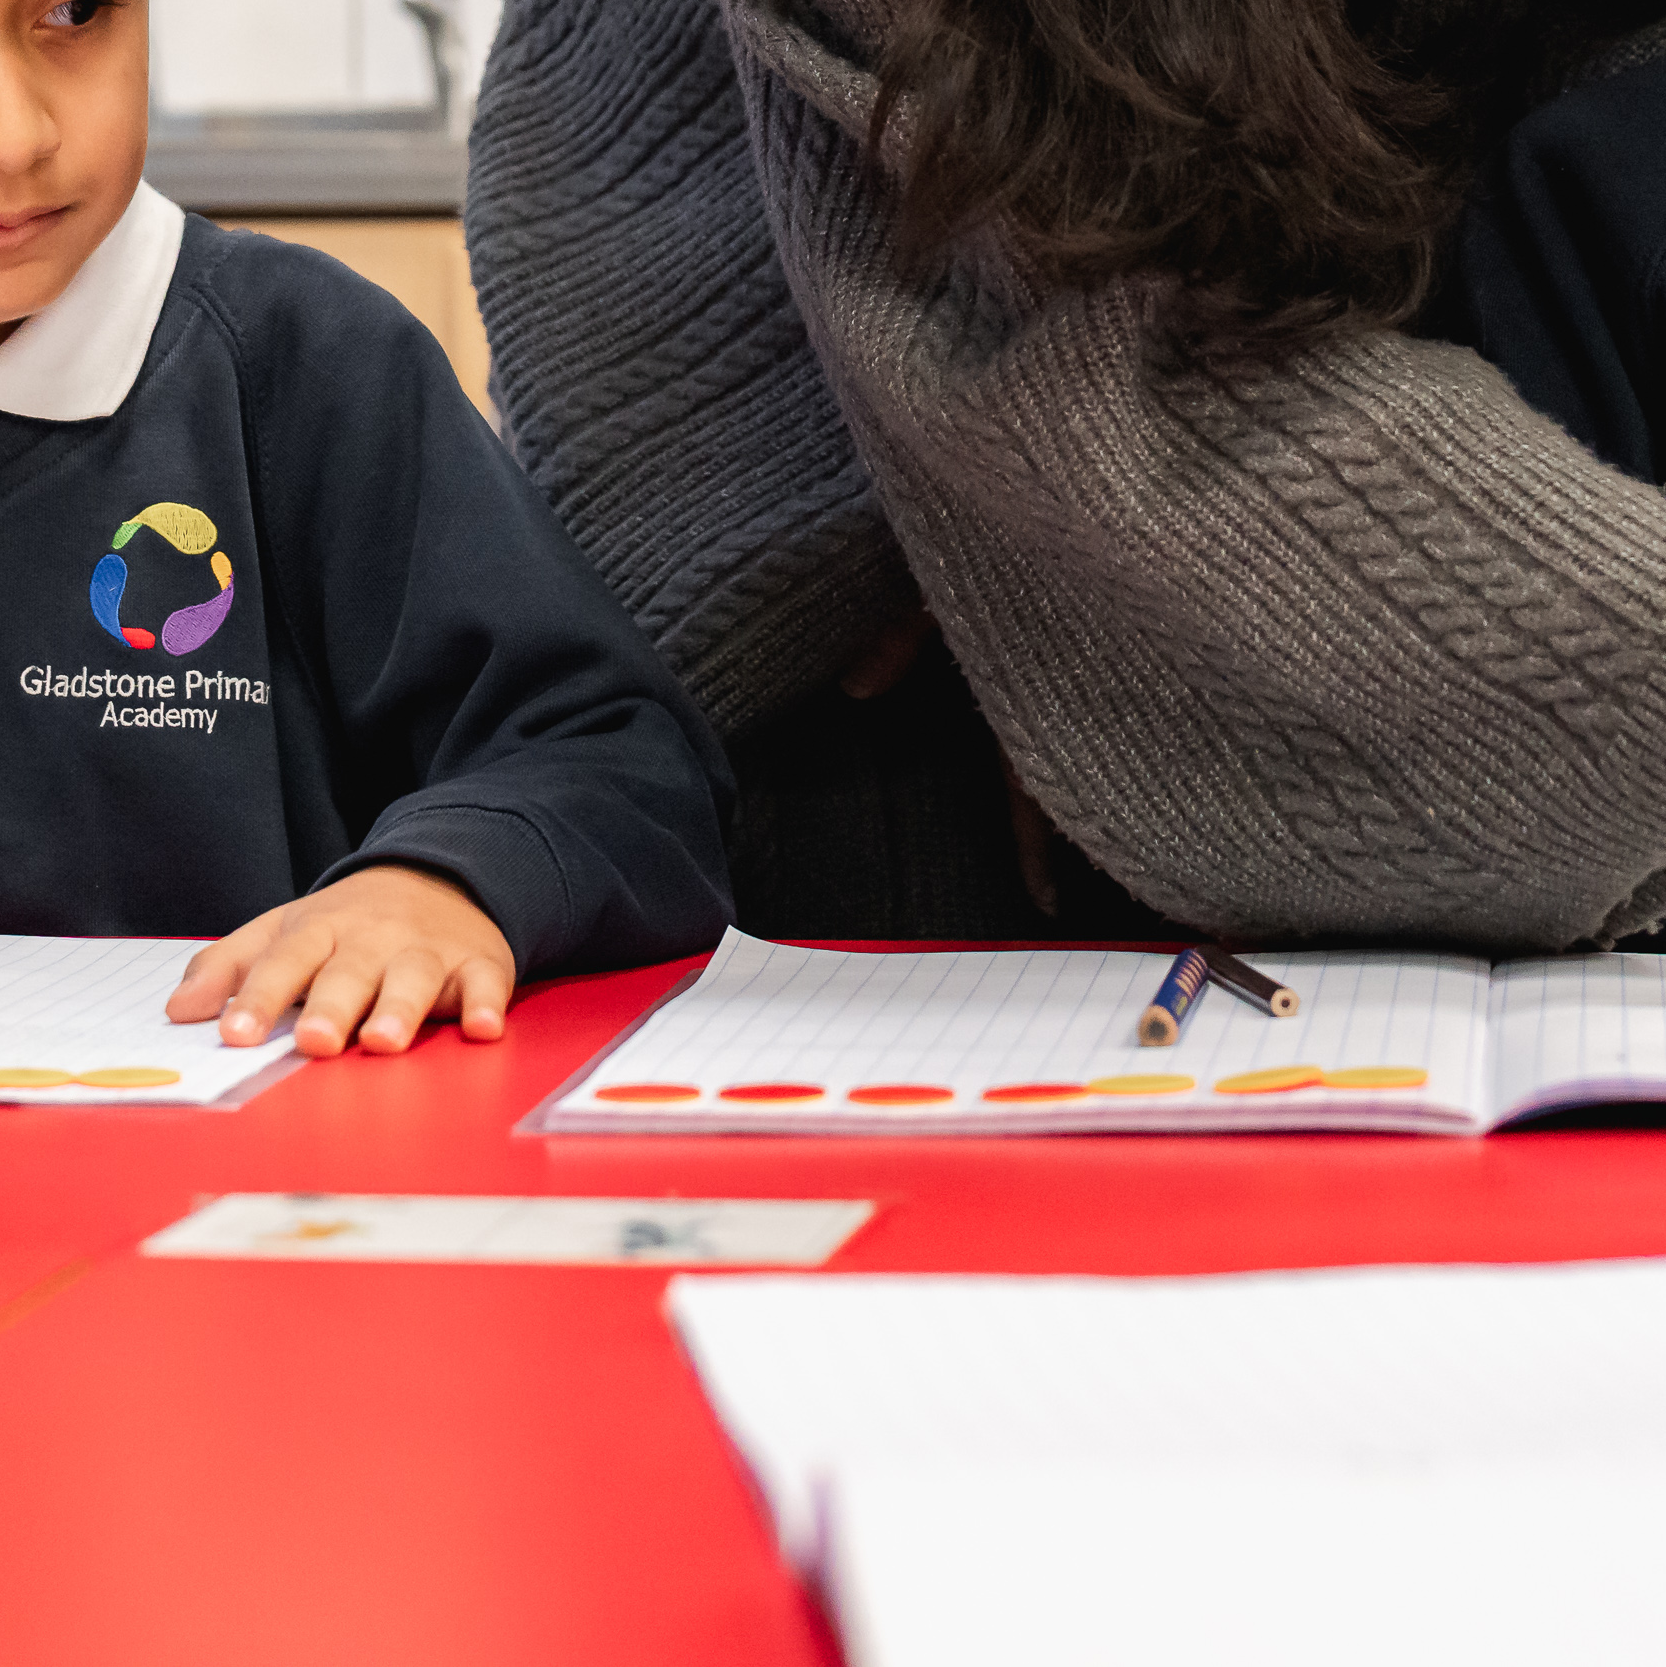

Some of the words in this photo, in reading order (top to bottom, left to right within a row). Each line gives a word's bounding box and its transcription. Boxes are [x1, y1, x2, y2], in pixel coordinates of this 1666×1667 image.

[20, 665, 176, 698] Gladstone
[185, 670, 272, 705] Primar
[99, 700, 218, 734] Academy
